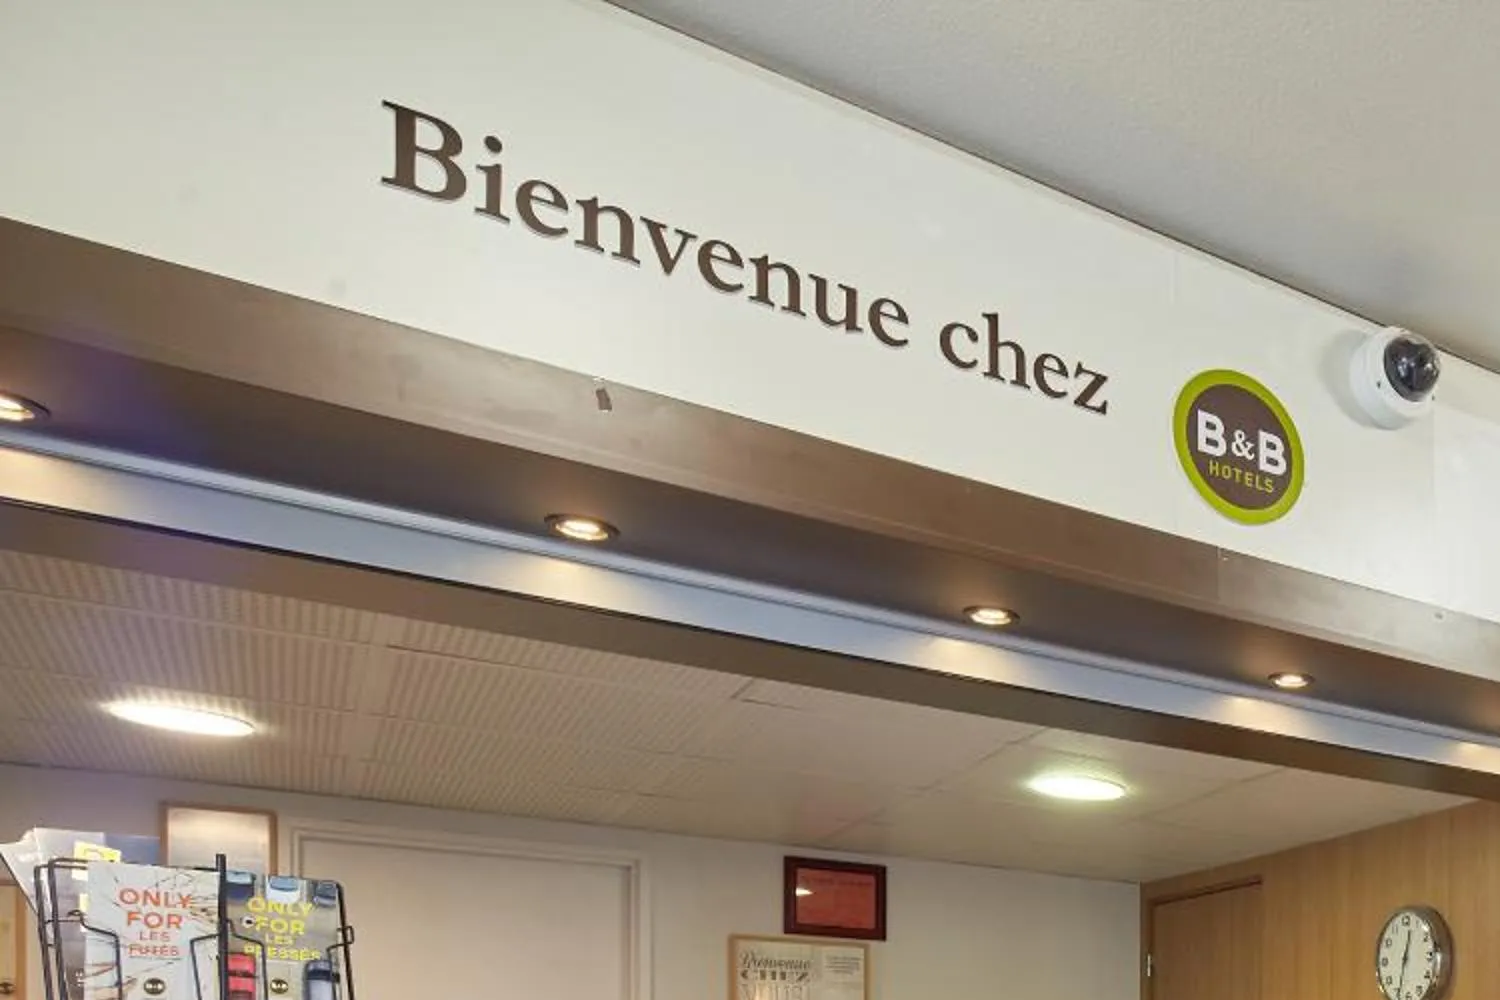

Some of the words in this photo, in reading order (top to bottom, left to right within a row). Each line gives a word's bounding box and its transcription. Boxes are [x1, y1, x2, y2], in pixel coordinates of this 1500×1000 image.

[380, 99, 911, 348] Bienvenue
[938, 313, 1110, 416] chez
[1197, 409, 1287, 476] B&B
[1208, 459, 1275, 494] HOTELS
[119, 888, 193, 909] ONLY
[247, 896, 314, 916] ONLY
[127, 911, 183, 929] FOR
[255, 915, 305, 935] FOR
